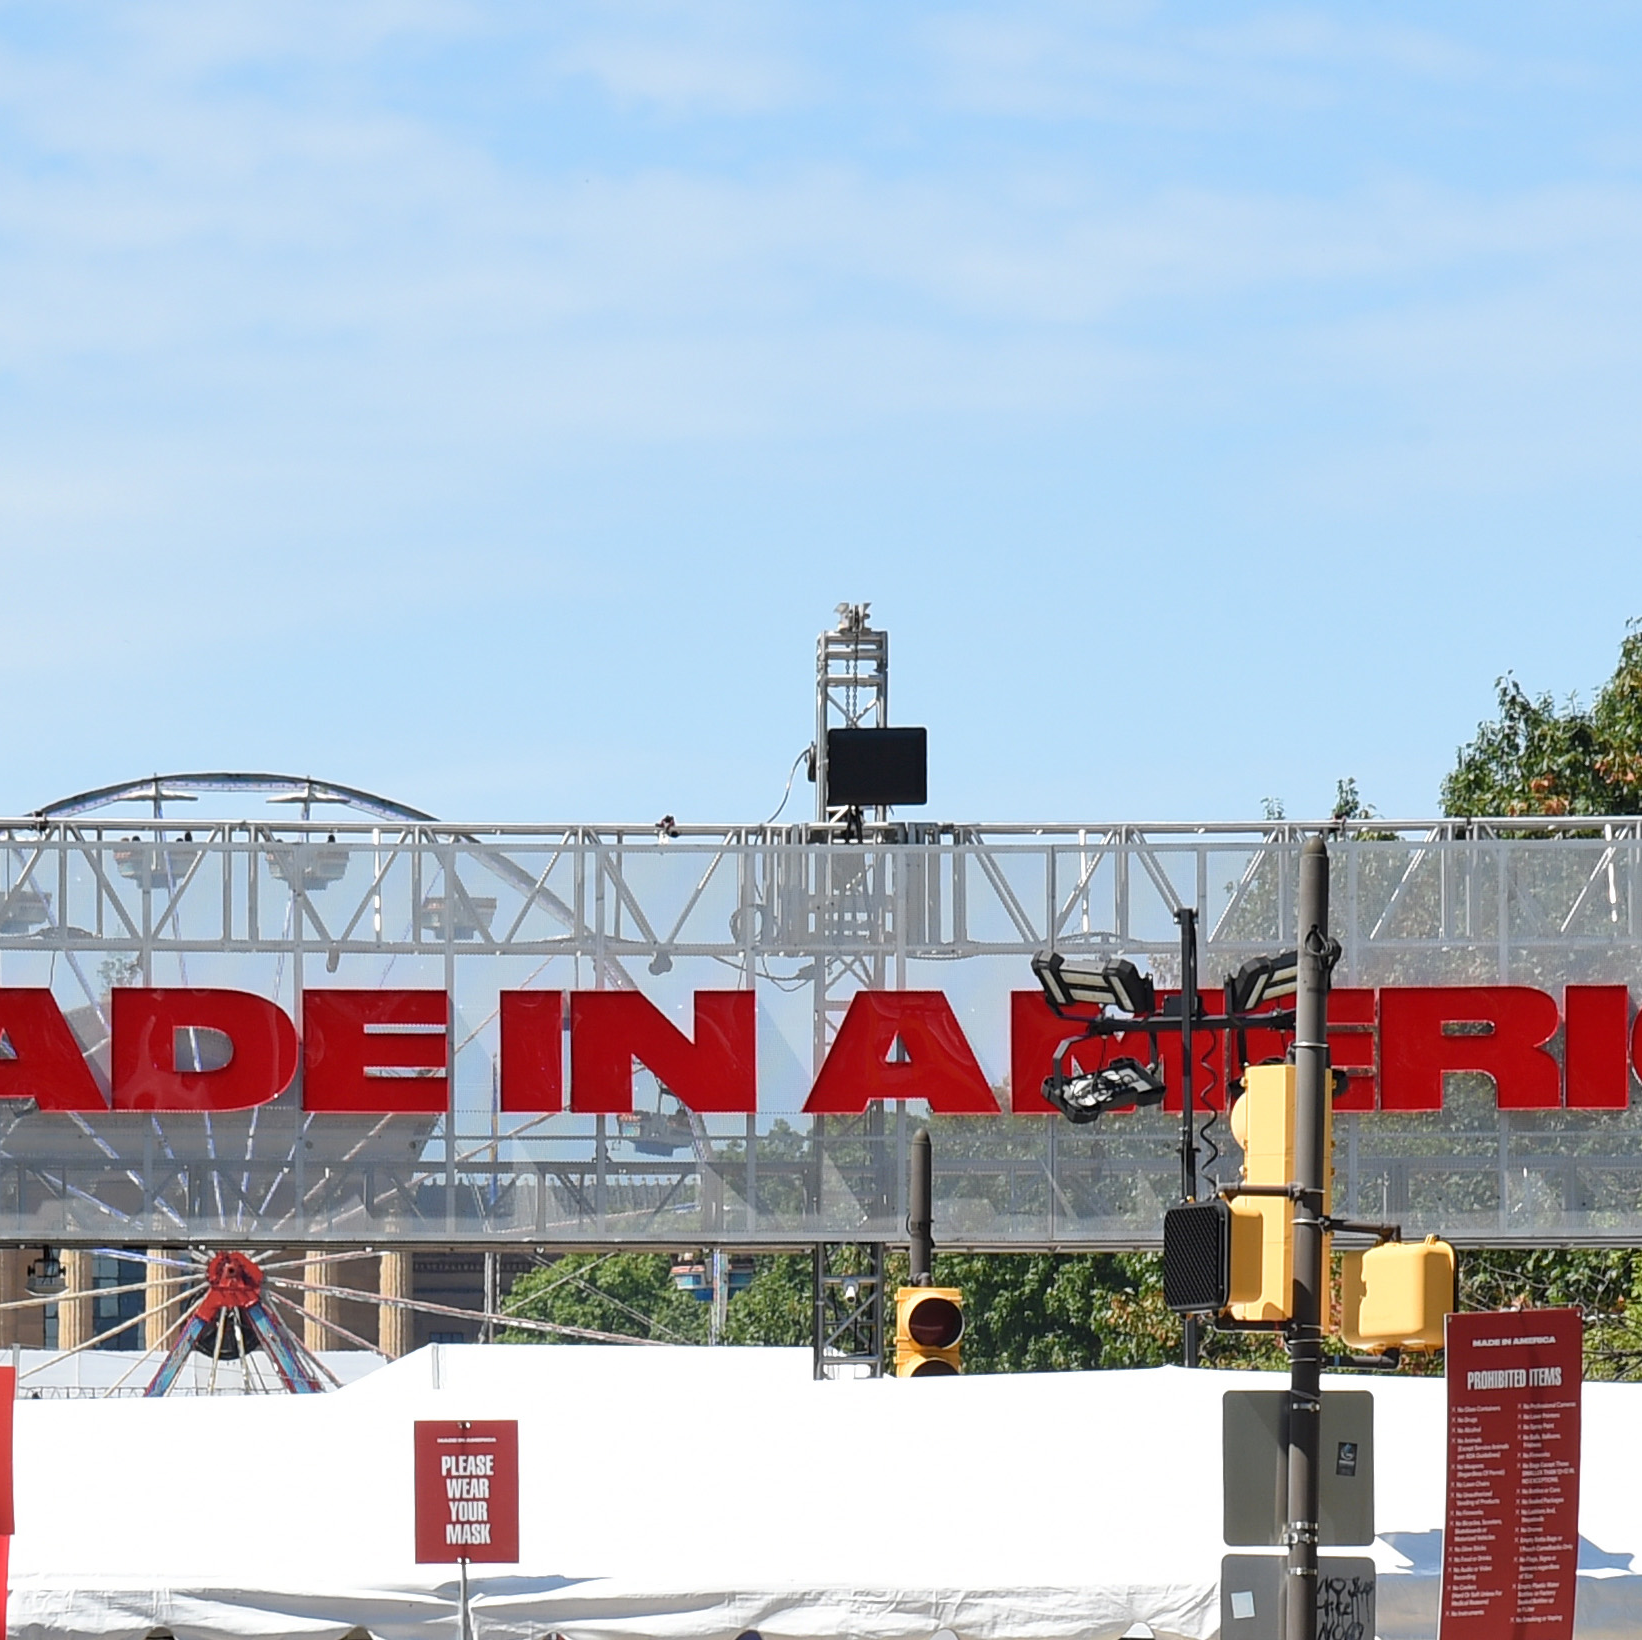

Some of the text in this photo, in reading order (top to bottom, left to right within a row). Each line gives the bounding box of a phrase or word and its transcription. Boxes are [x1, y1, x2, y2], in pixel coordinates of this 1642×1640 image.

[499, 989, 757, 1114] IN
[1473, 1336, 1556, 1348] MADE IN AMERICA
[1467, 1366, 1562, 1390] PROHIBITED ITEMS
[441, 1455, 494, 1476] PLEASE
[447, 1478, 489, 1499] WEAR
[449, 1500, 487, 1522] YOUR
[446, 1523, 491, 1545] MASK
